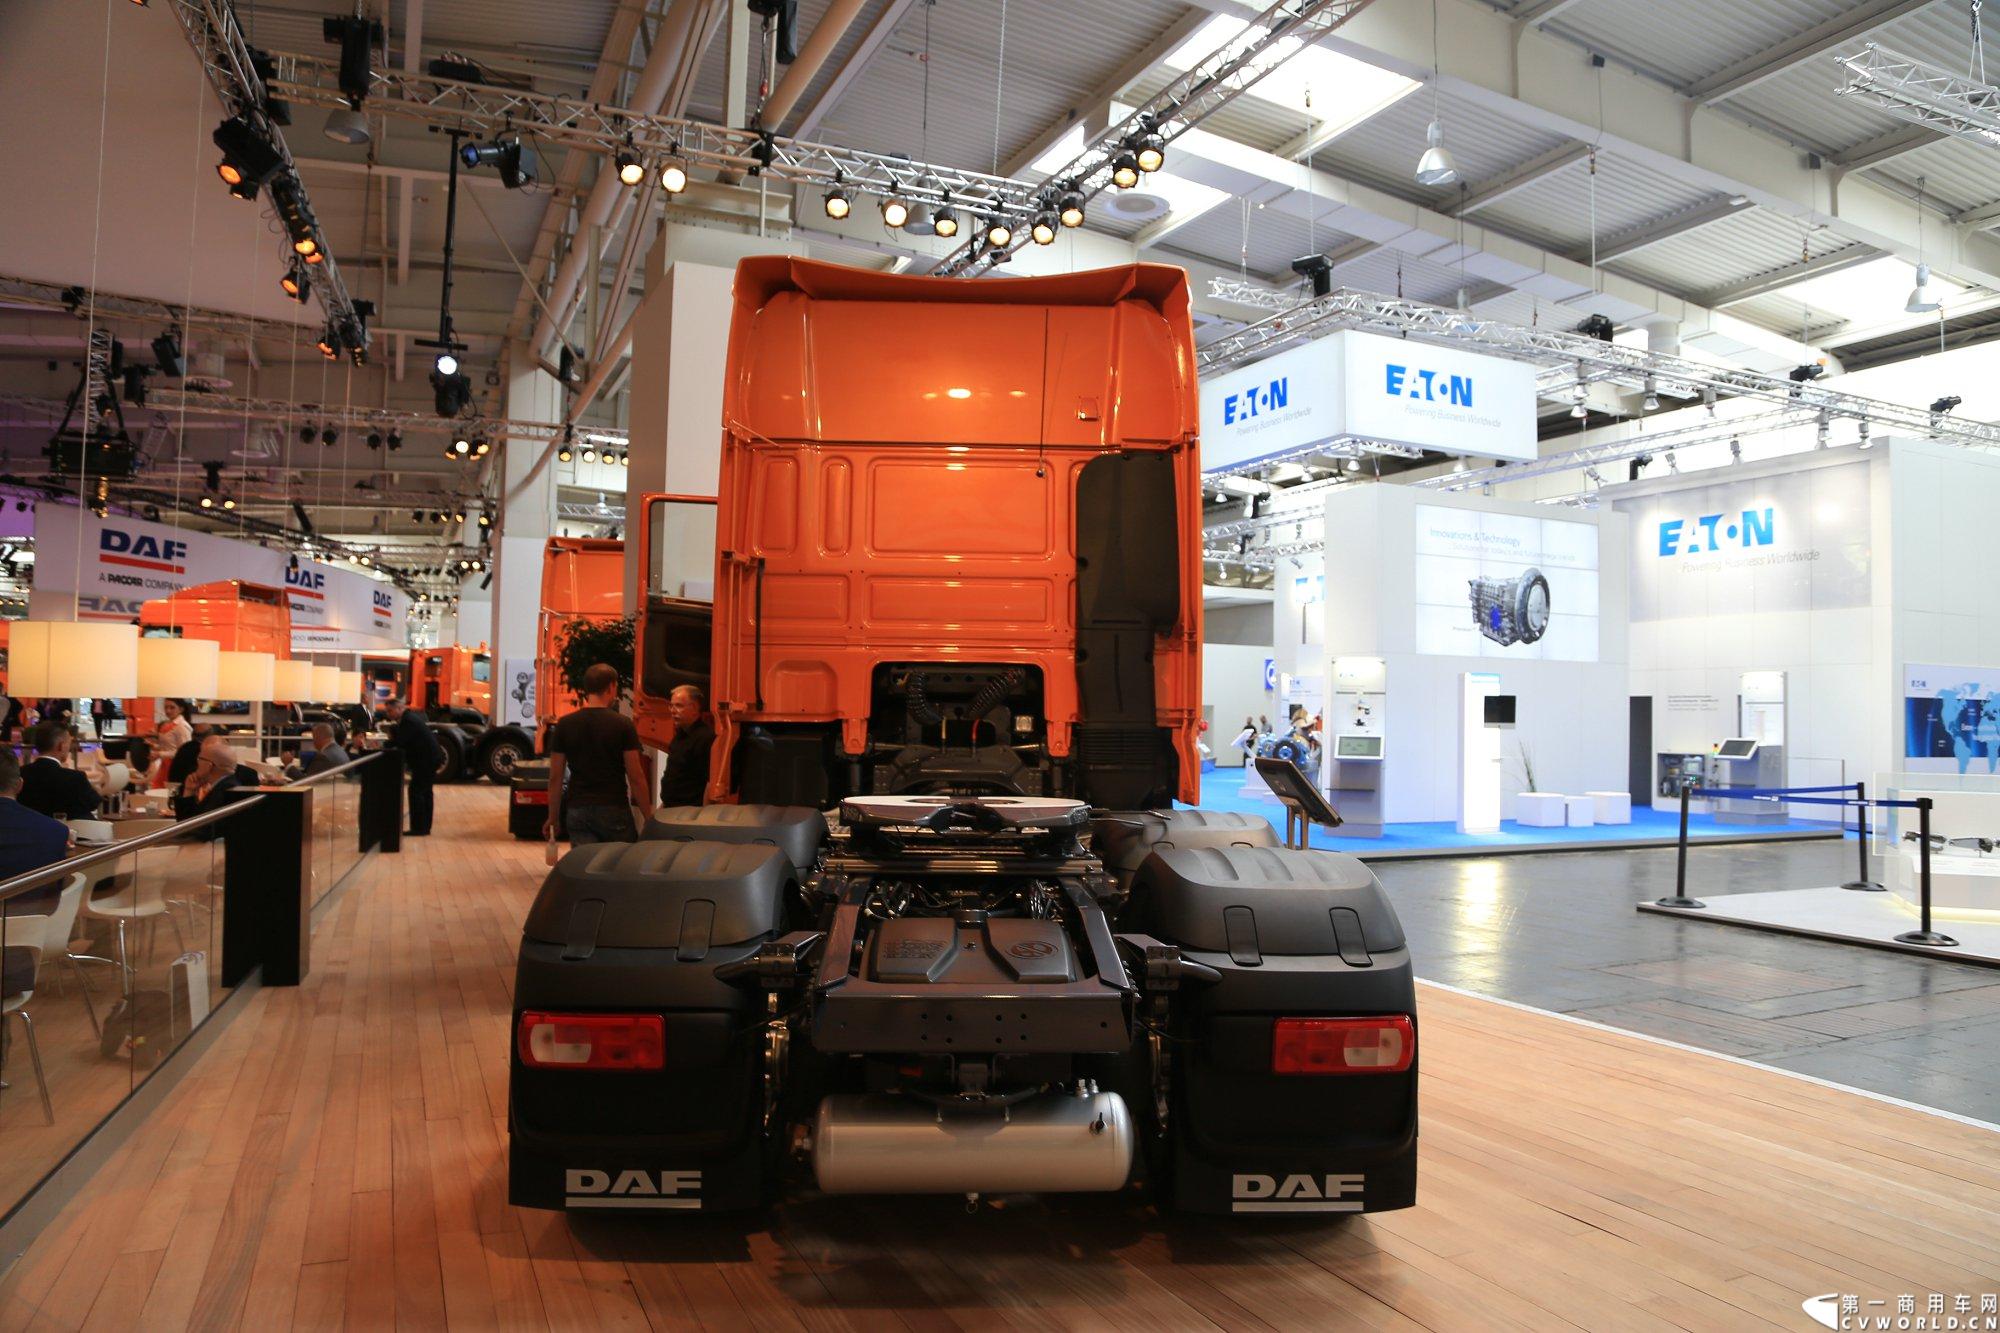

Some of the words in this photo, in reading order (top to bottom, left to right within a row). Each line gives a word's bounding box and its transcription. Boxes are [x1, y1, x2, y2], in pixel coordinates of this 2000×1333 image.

[1386, 364, 1473, 408] EATON
[1224, 377, 1287, 426] EATON
[101, 529, 187, 560] DAF
[1659, 507, 1774, 557] EATON
[1767, 549, 1821, 565] Worldwide
[285, 566, 325, 589] DAF
[373, 590, 392, 608] DAF
[566, 1169, 702, 1194] DAF
[1232, 1174, 1365, 1198] DAF
